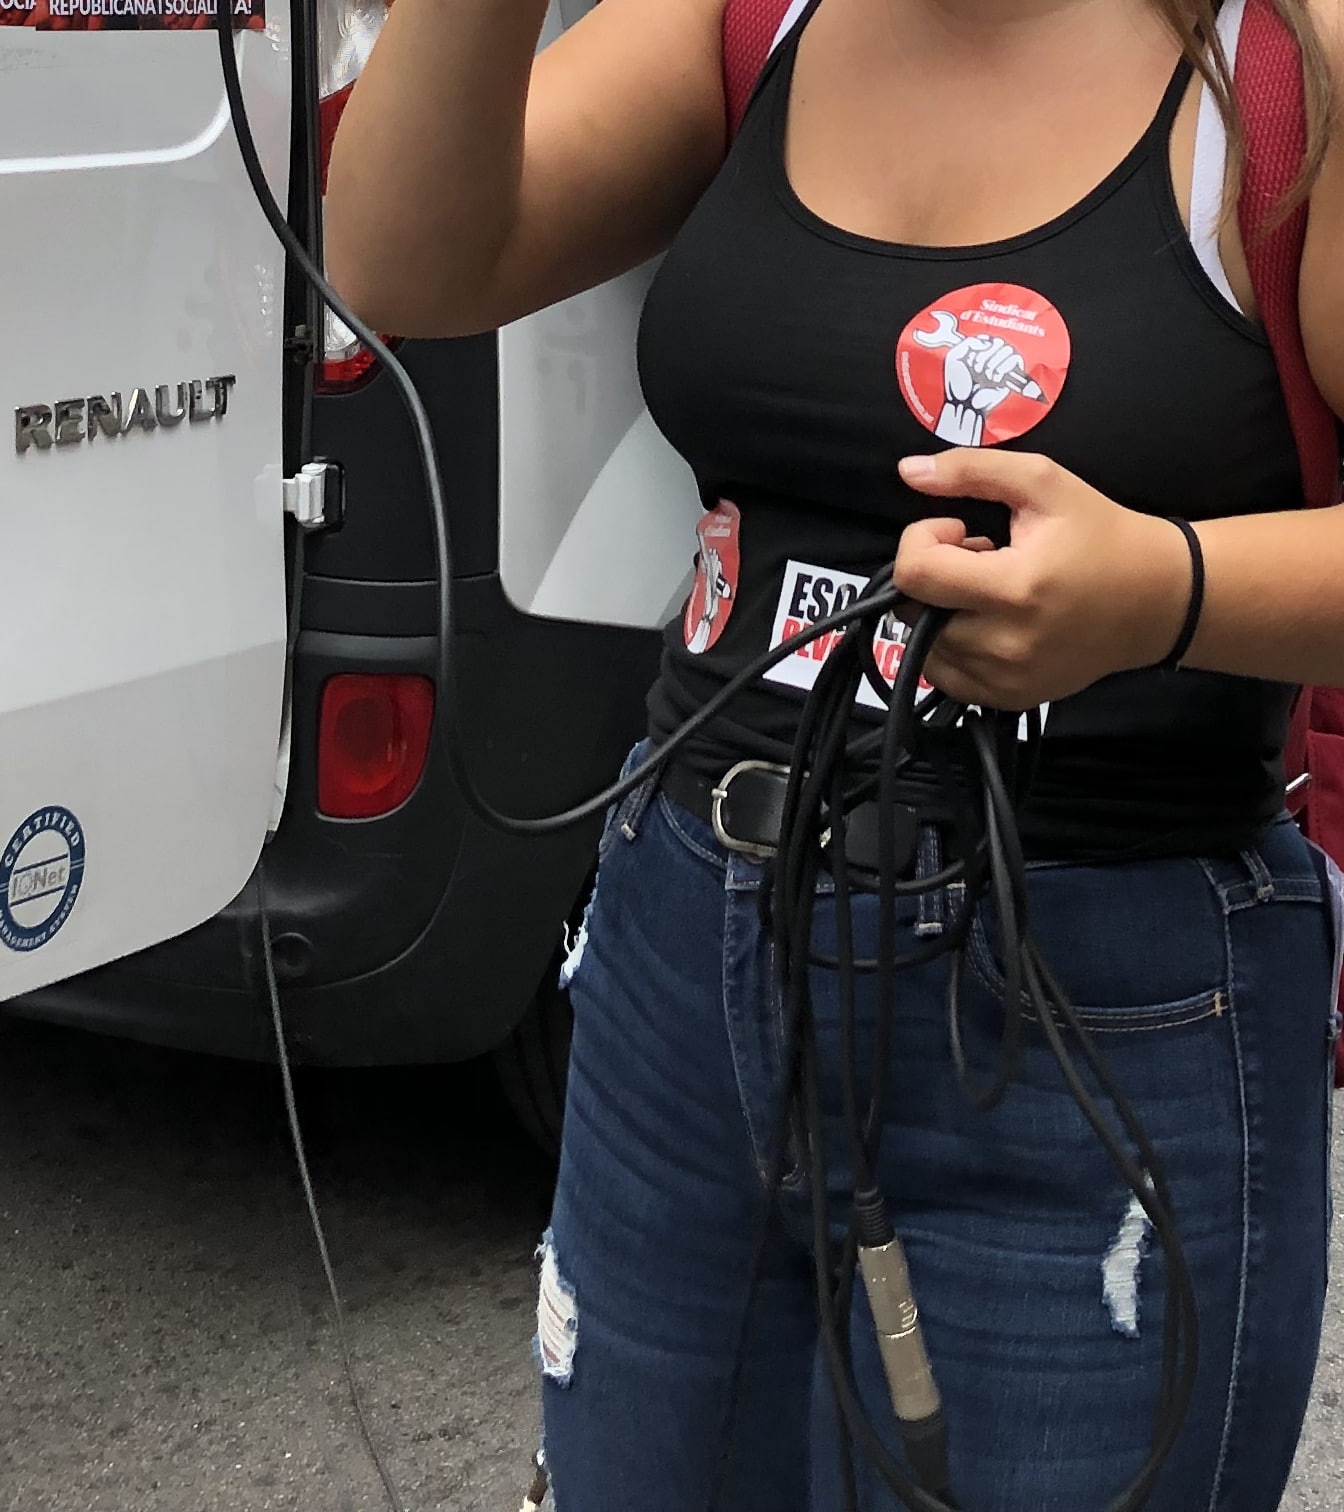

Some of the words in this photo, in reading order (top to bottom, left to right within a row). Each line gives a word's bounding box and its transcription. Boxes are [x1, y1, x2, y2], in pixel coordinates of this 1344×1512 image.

[959, 308, 1046, 338] d'Estudiants
[980, 298, 1039, 322] Sindicat
[14, 374, 237, 454] RENAULT
[4, 811, 81, 868] CERTIFIED
